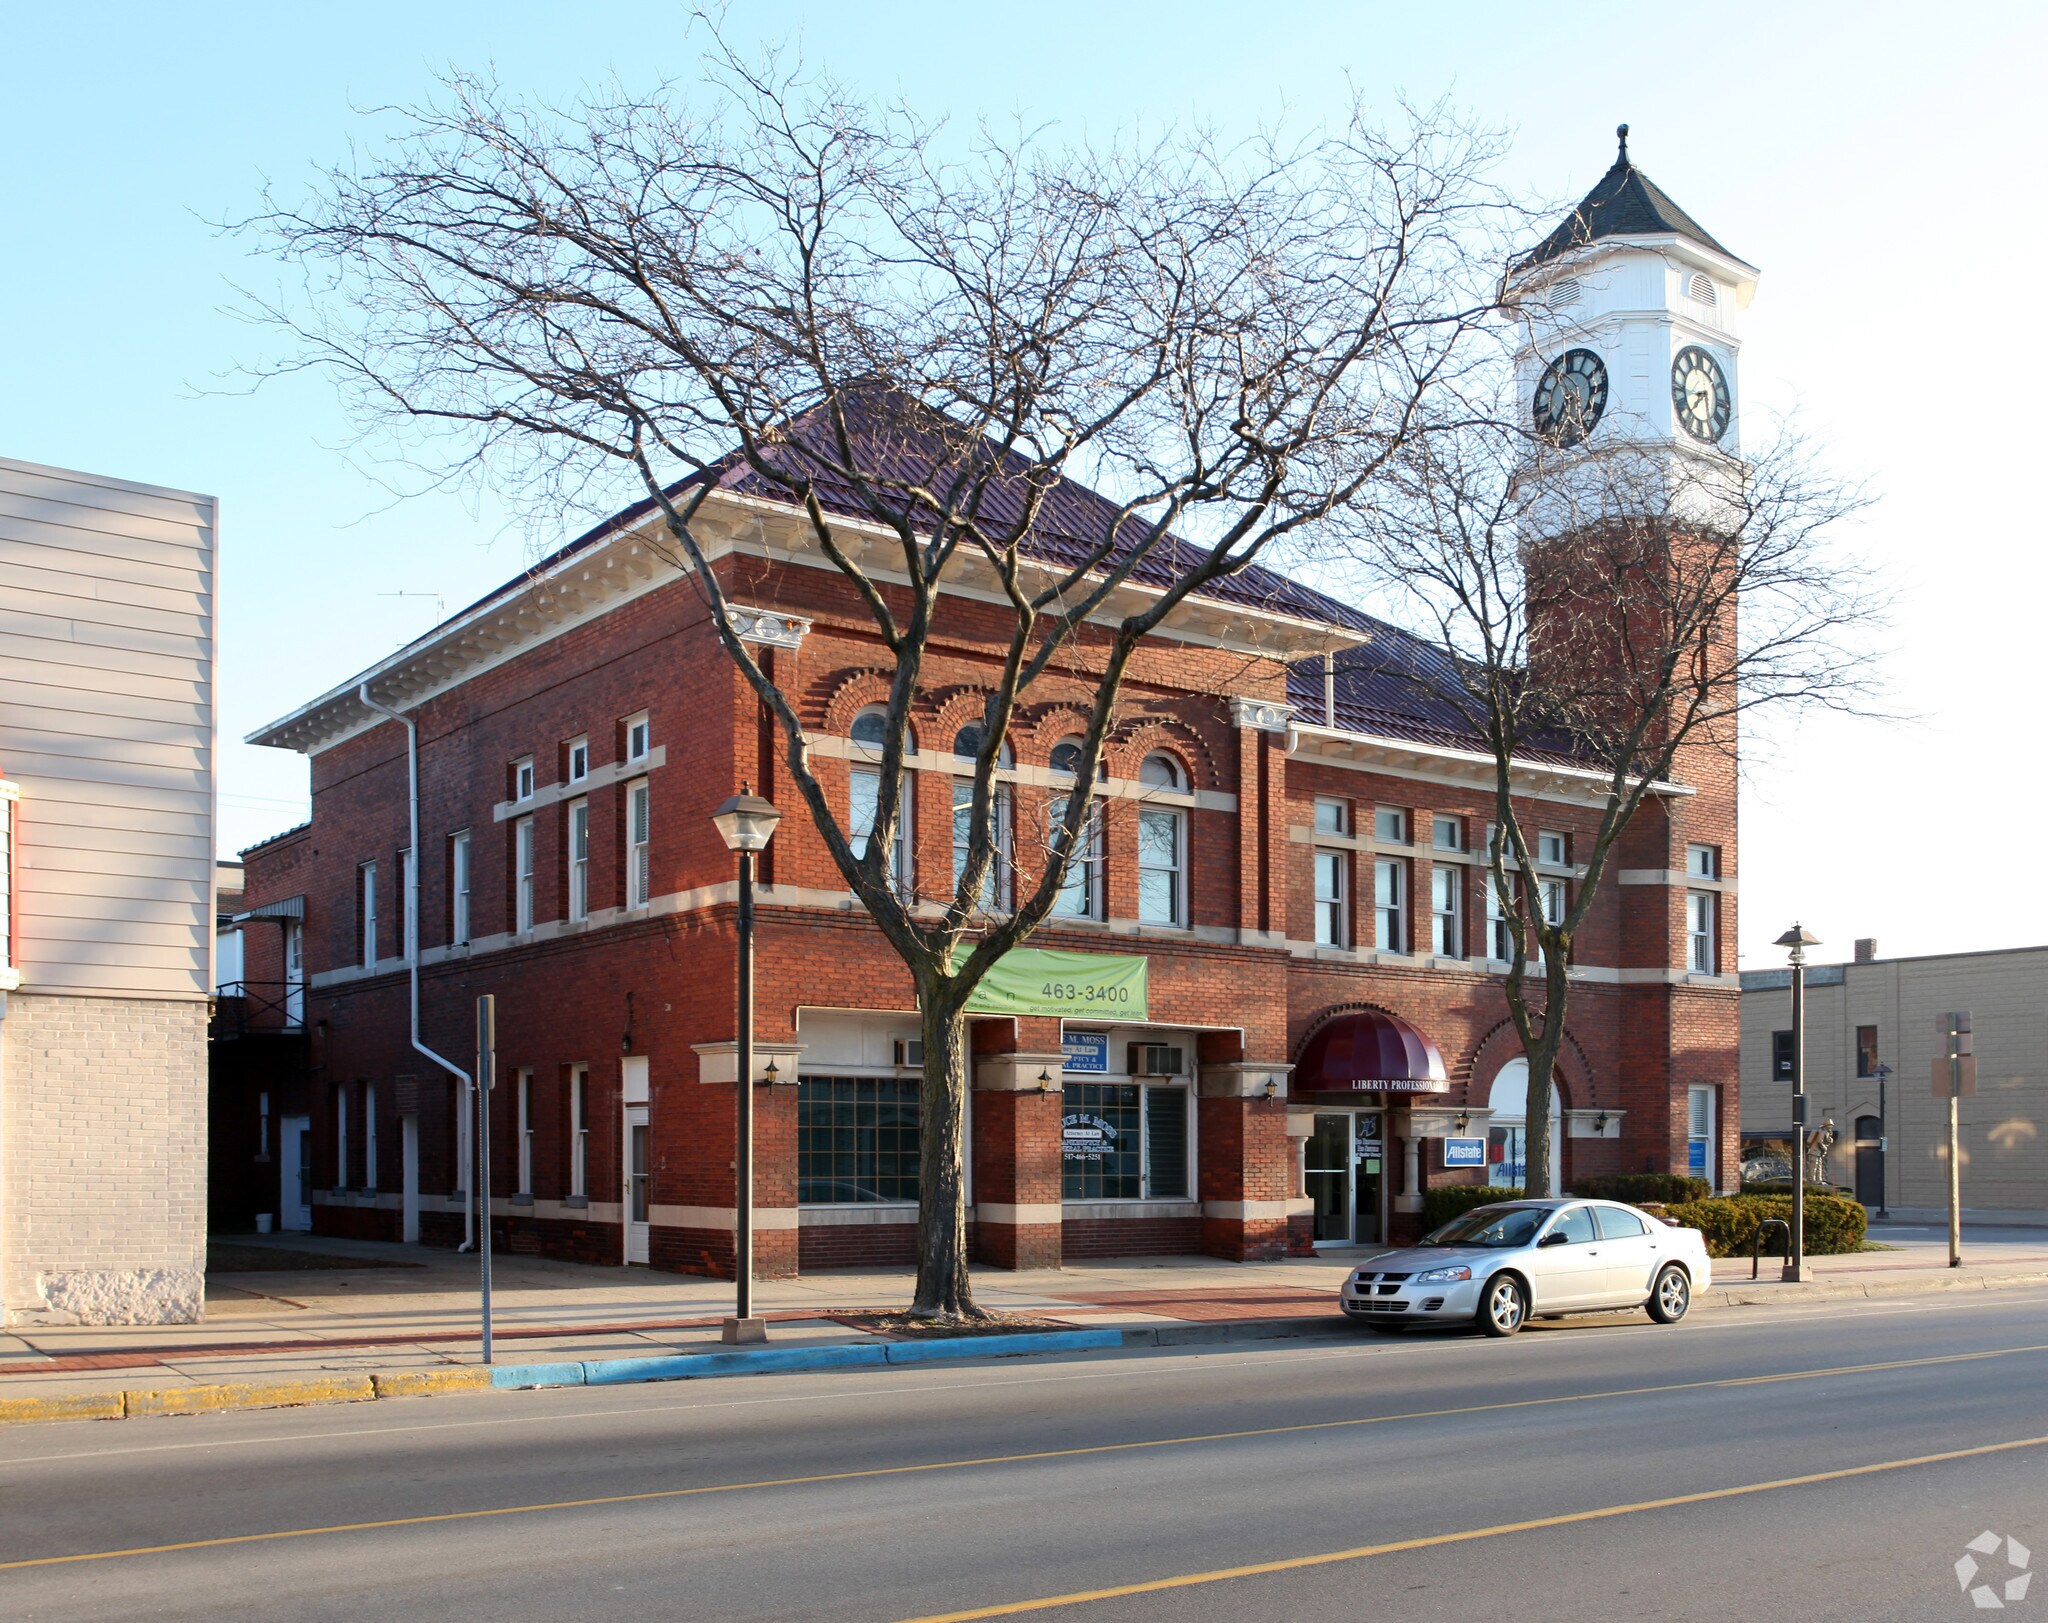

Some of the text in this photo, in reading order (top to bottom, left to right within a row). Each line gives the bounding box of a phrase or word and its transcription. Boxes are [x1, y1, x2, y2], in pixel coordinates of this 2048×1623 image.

[1042, 983, 1128, 1002] 463-3400
[1082, 1035, 1106, 1045] MOSS
[1352, 1080, 1389, 1090] LIBERTY
[1447, 1145, 1482, 1159] Allstate
[1496, 1163, 1526, 1177] Allsta
